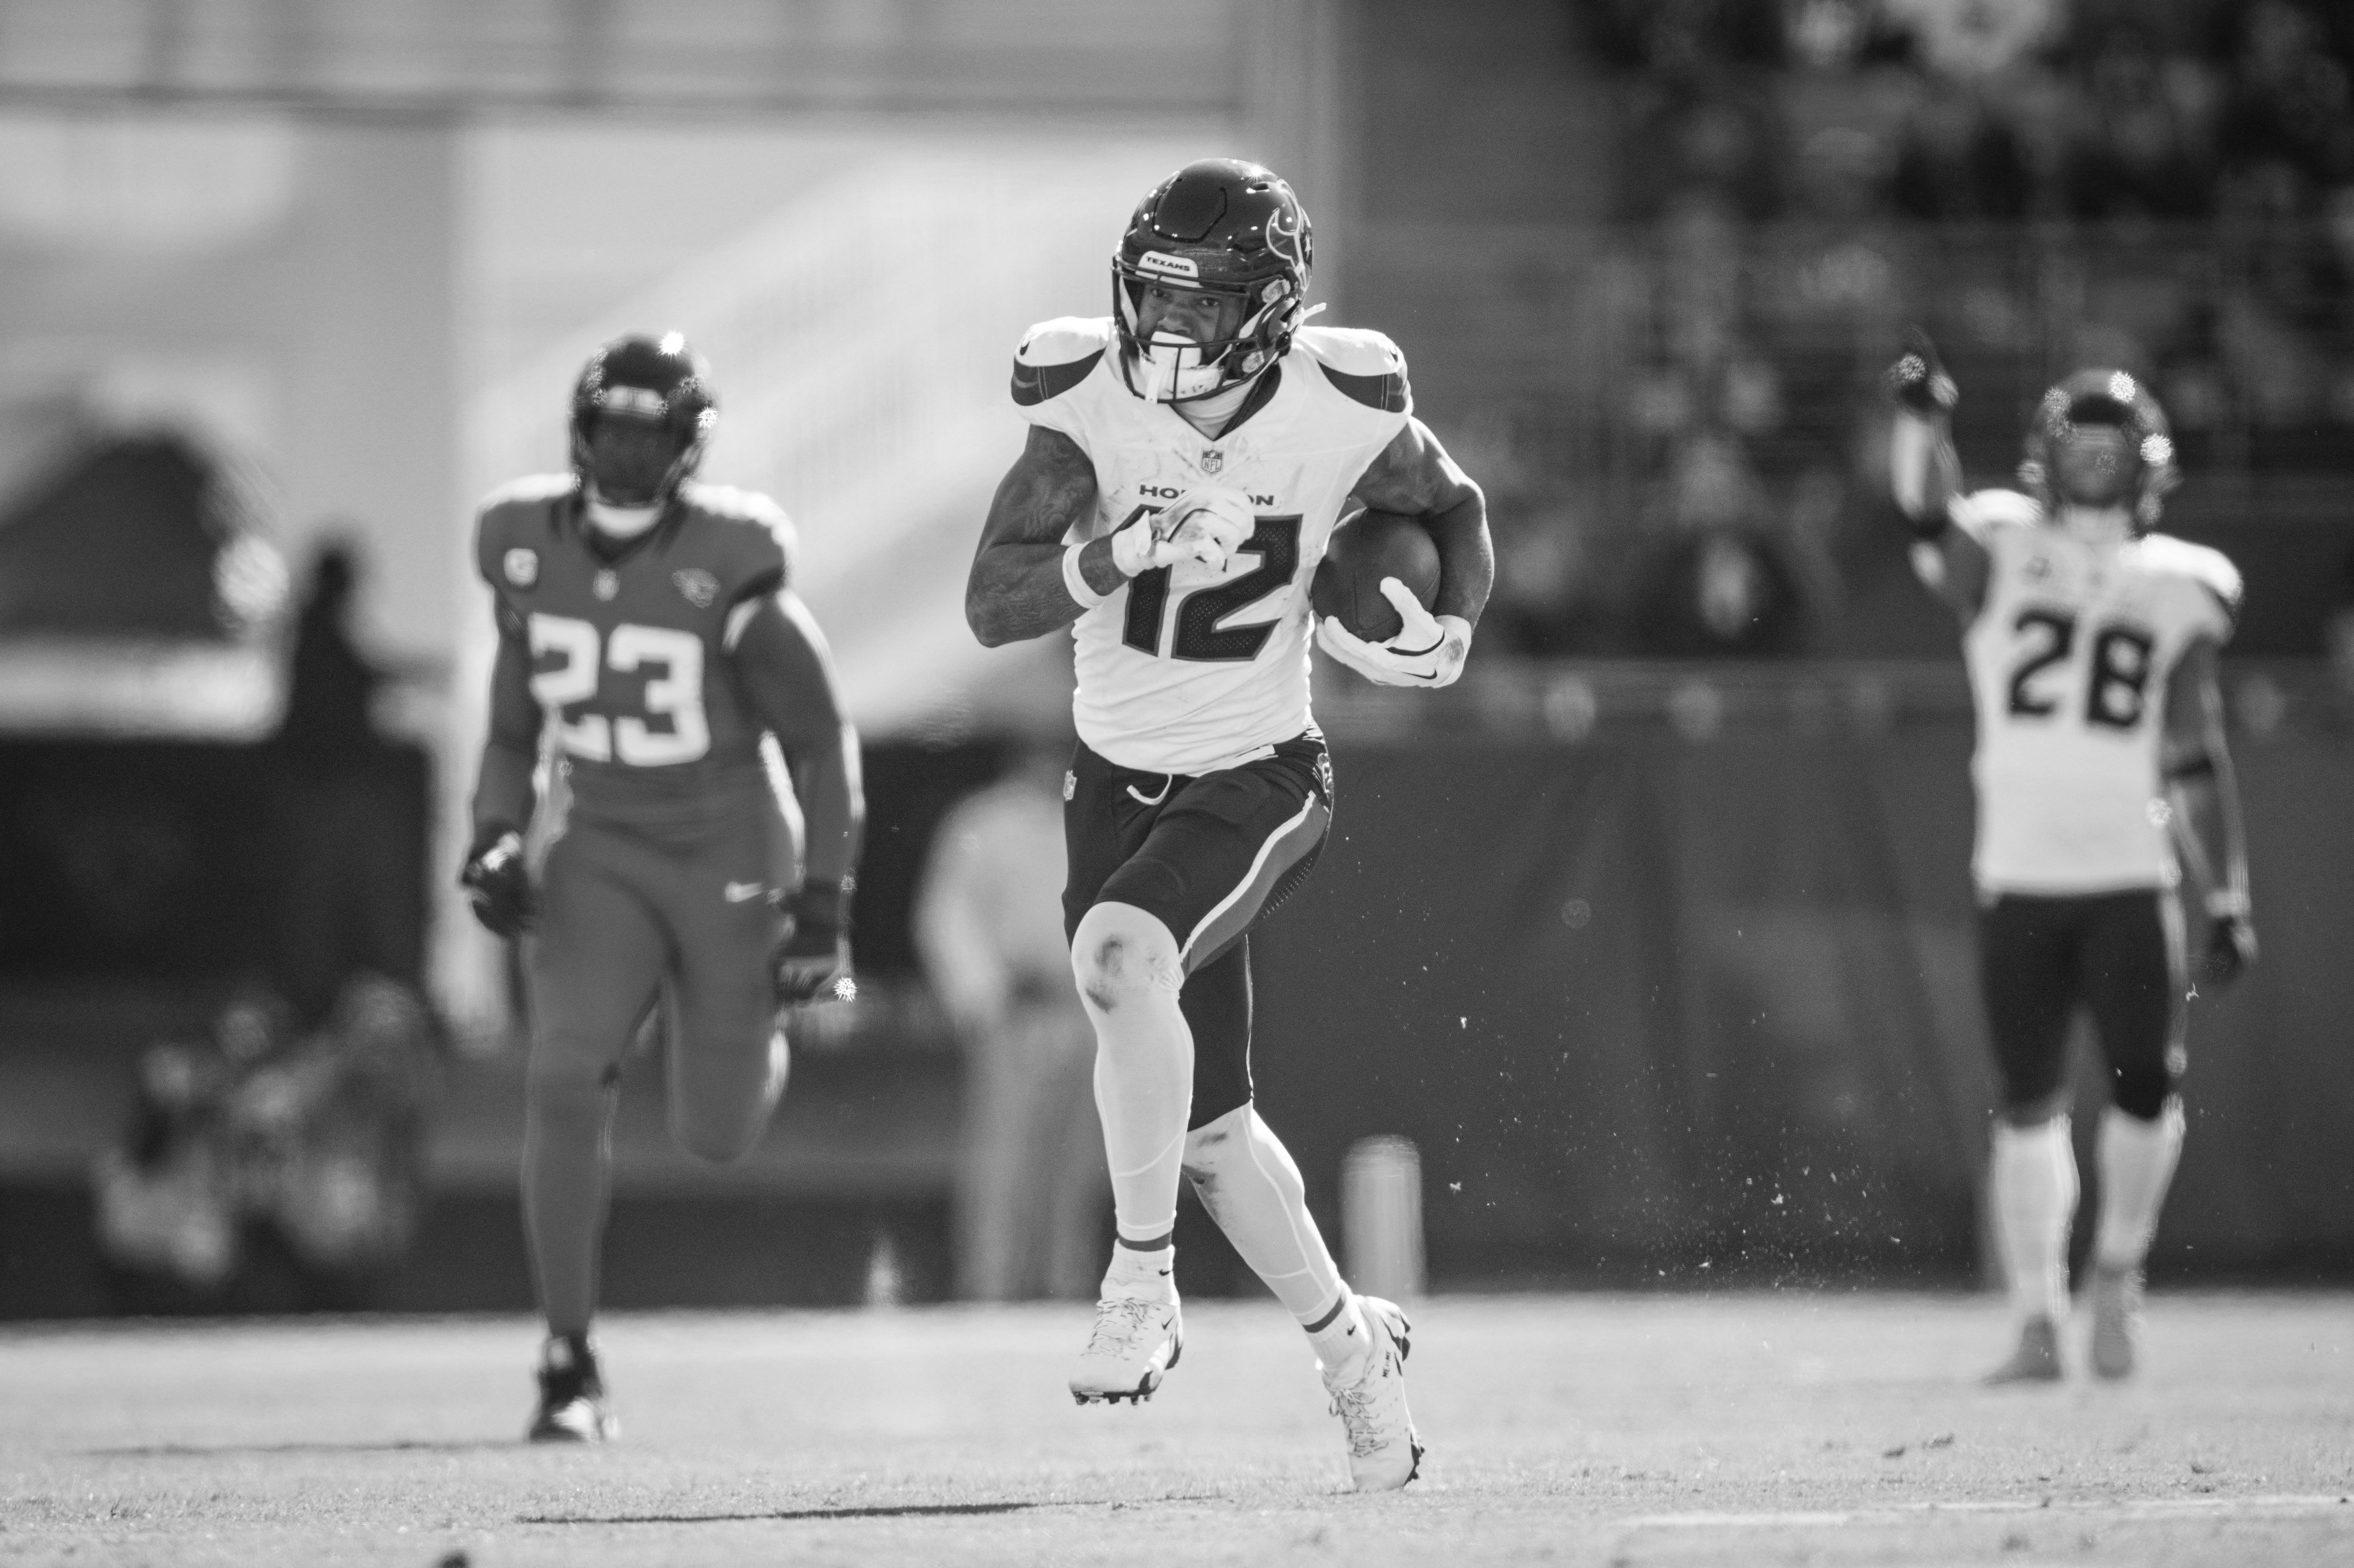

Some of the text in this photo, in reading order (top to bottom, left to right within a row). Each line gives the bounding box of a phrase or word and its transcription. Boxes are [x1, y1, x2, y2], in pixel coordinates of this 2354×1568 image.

[1147, 256, 1190, 271] TEXANS
[1204, 458, 1221, 471] NFL
[1112, 504, 1303, 662] 12
[529, 612, 710, 767] 23
[2008, 606, 2155, 729] 28
